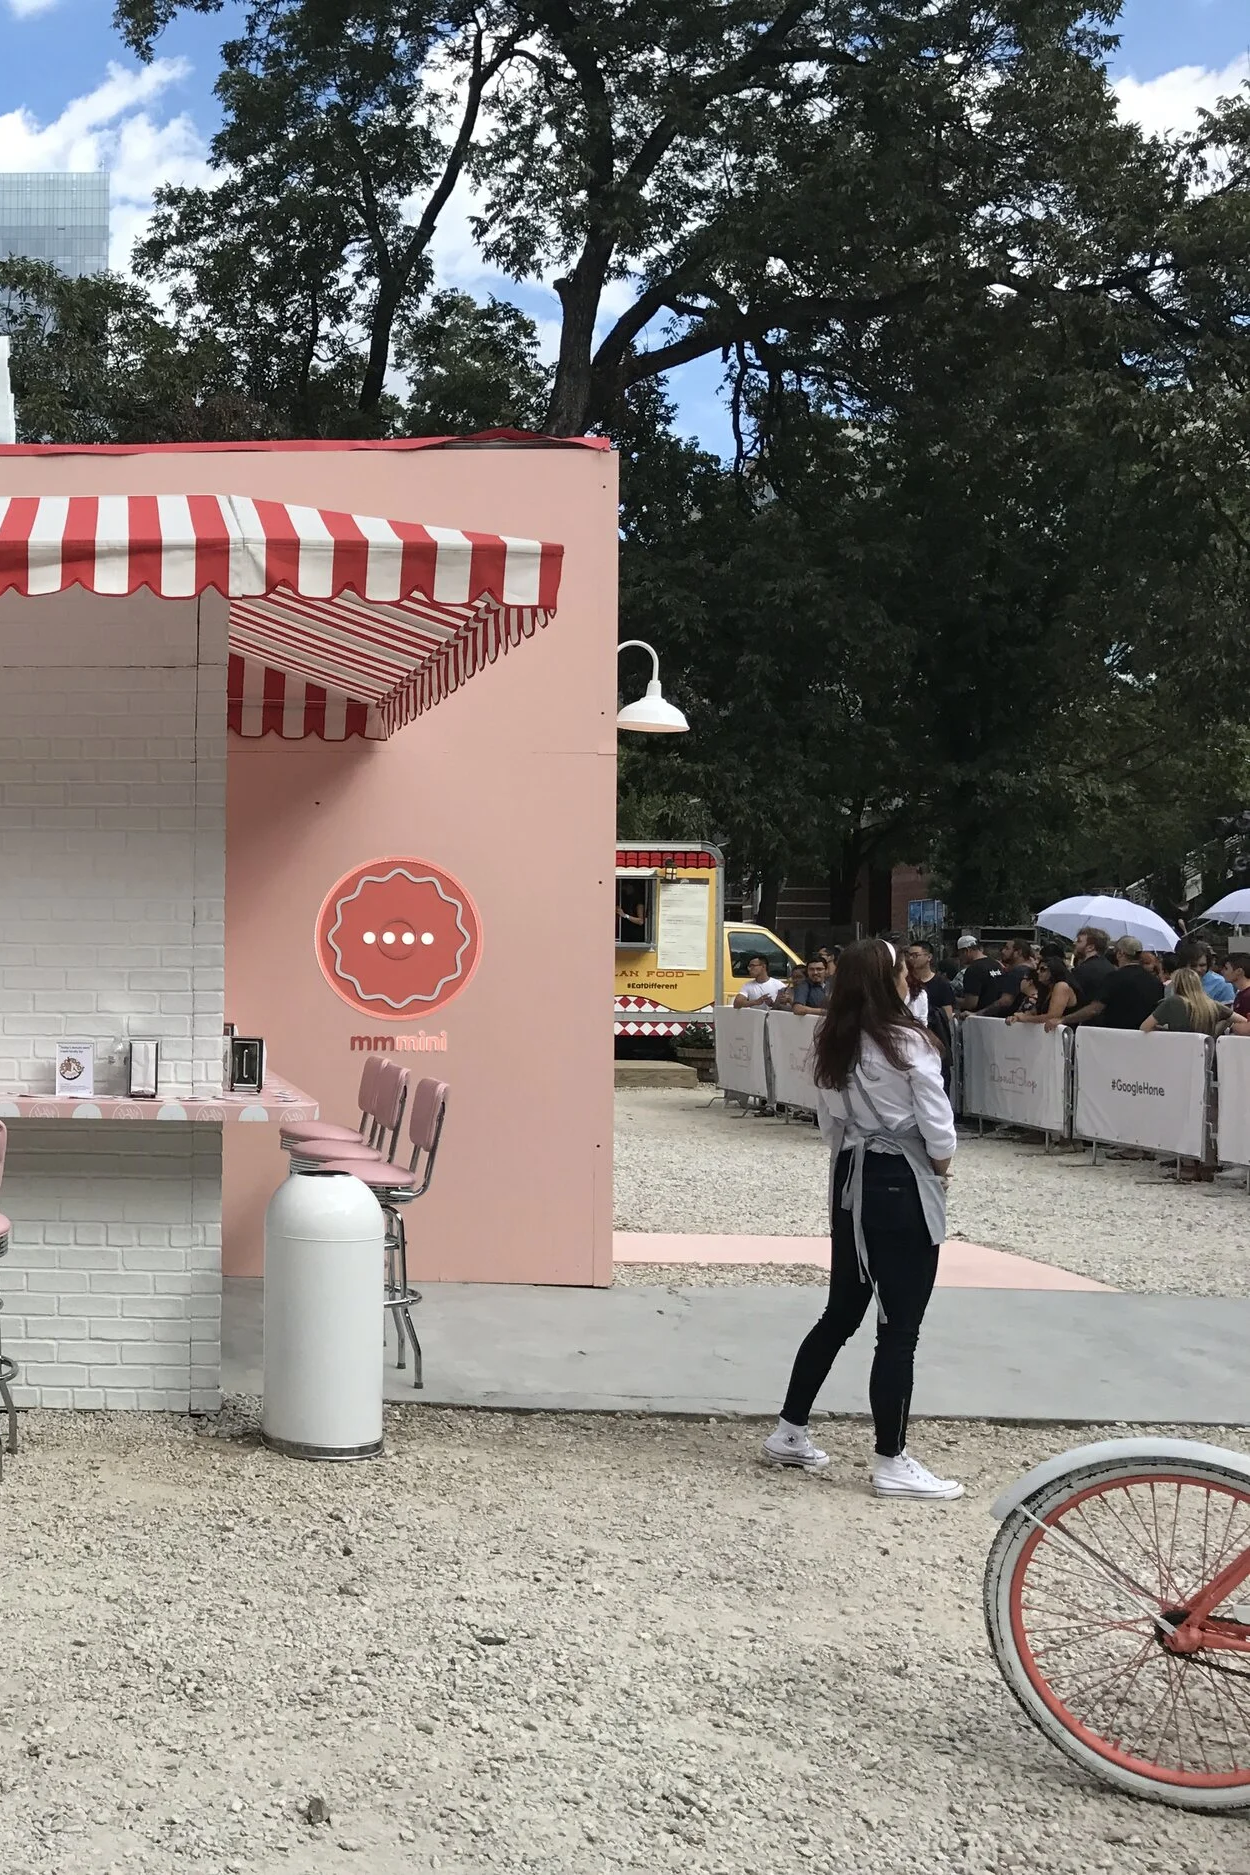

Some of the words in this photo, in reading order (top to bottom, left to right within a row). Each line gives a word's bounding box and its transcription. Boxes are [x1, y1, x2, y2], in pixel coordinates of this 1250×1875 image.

[646, 971, 684, 979] FOOD
[627, 982, 678, 990] #EatDifferent
[350, 1030, 447, 1052] mmmini
